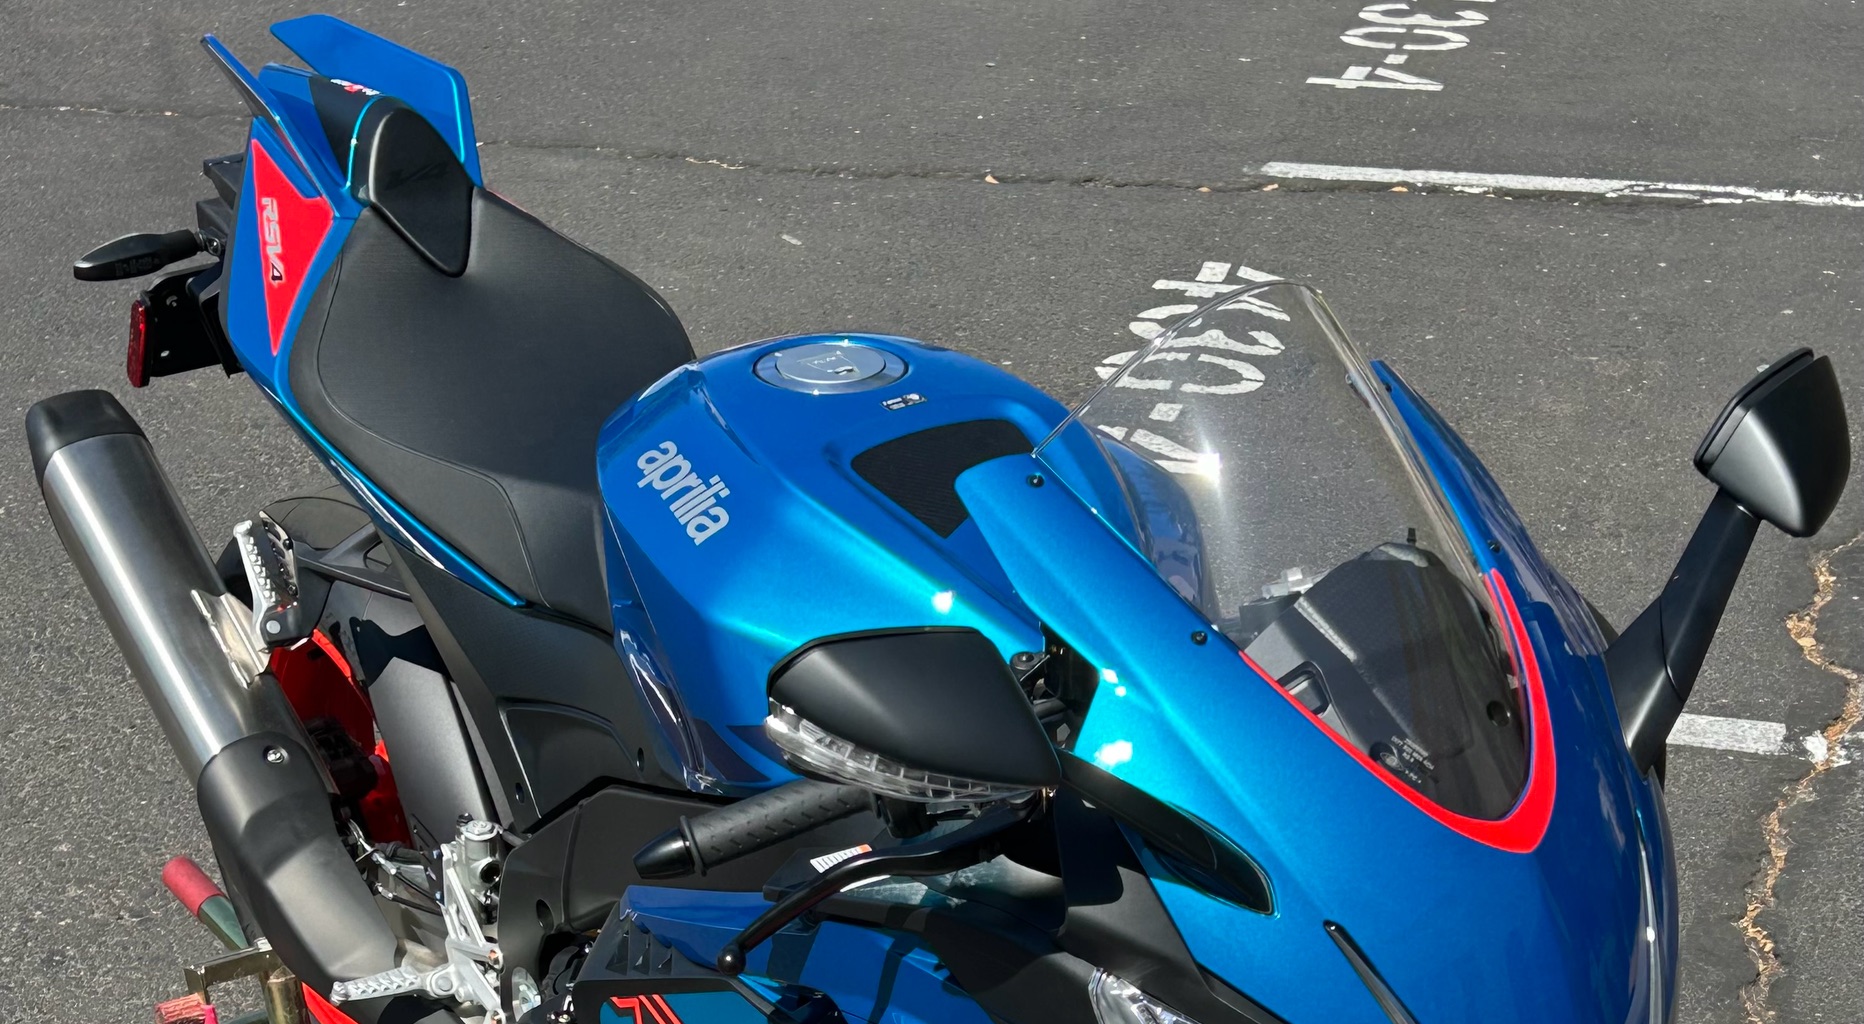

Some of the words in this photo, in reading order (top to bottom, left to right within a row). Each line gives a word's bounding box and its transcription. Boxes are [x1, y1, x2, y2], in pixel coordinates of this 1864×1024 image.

[1306, 0, 1495, 91] 30-4
[261, 197, 286, 288] RSV4
[636, 440, 730, 545] aprilia
